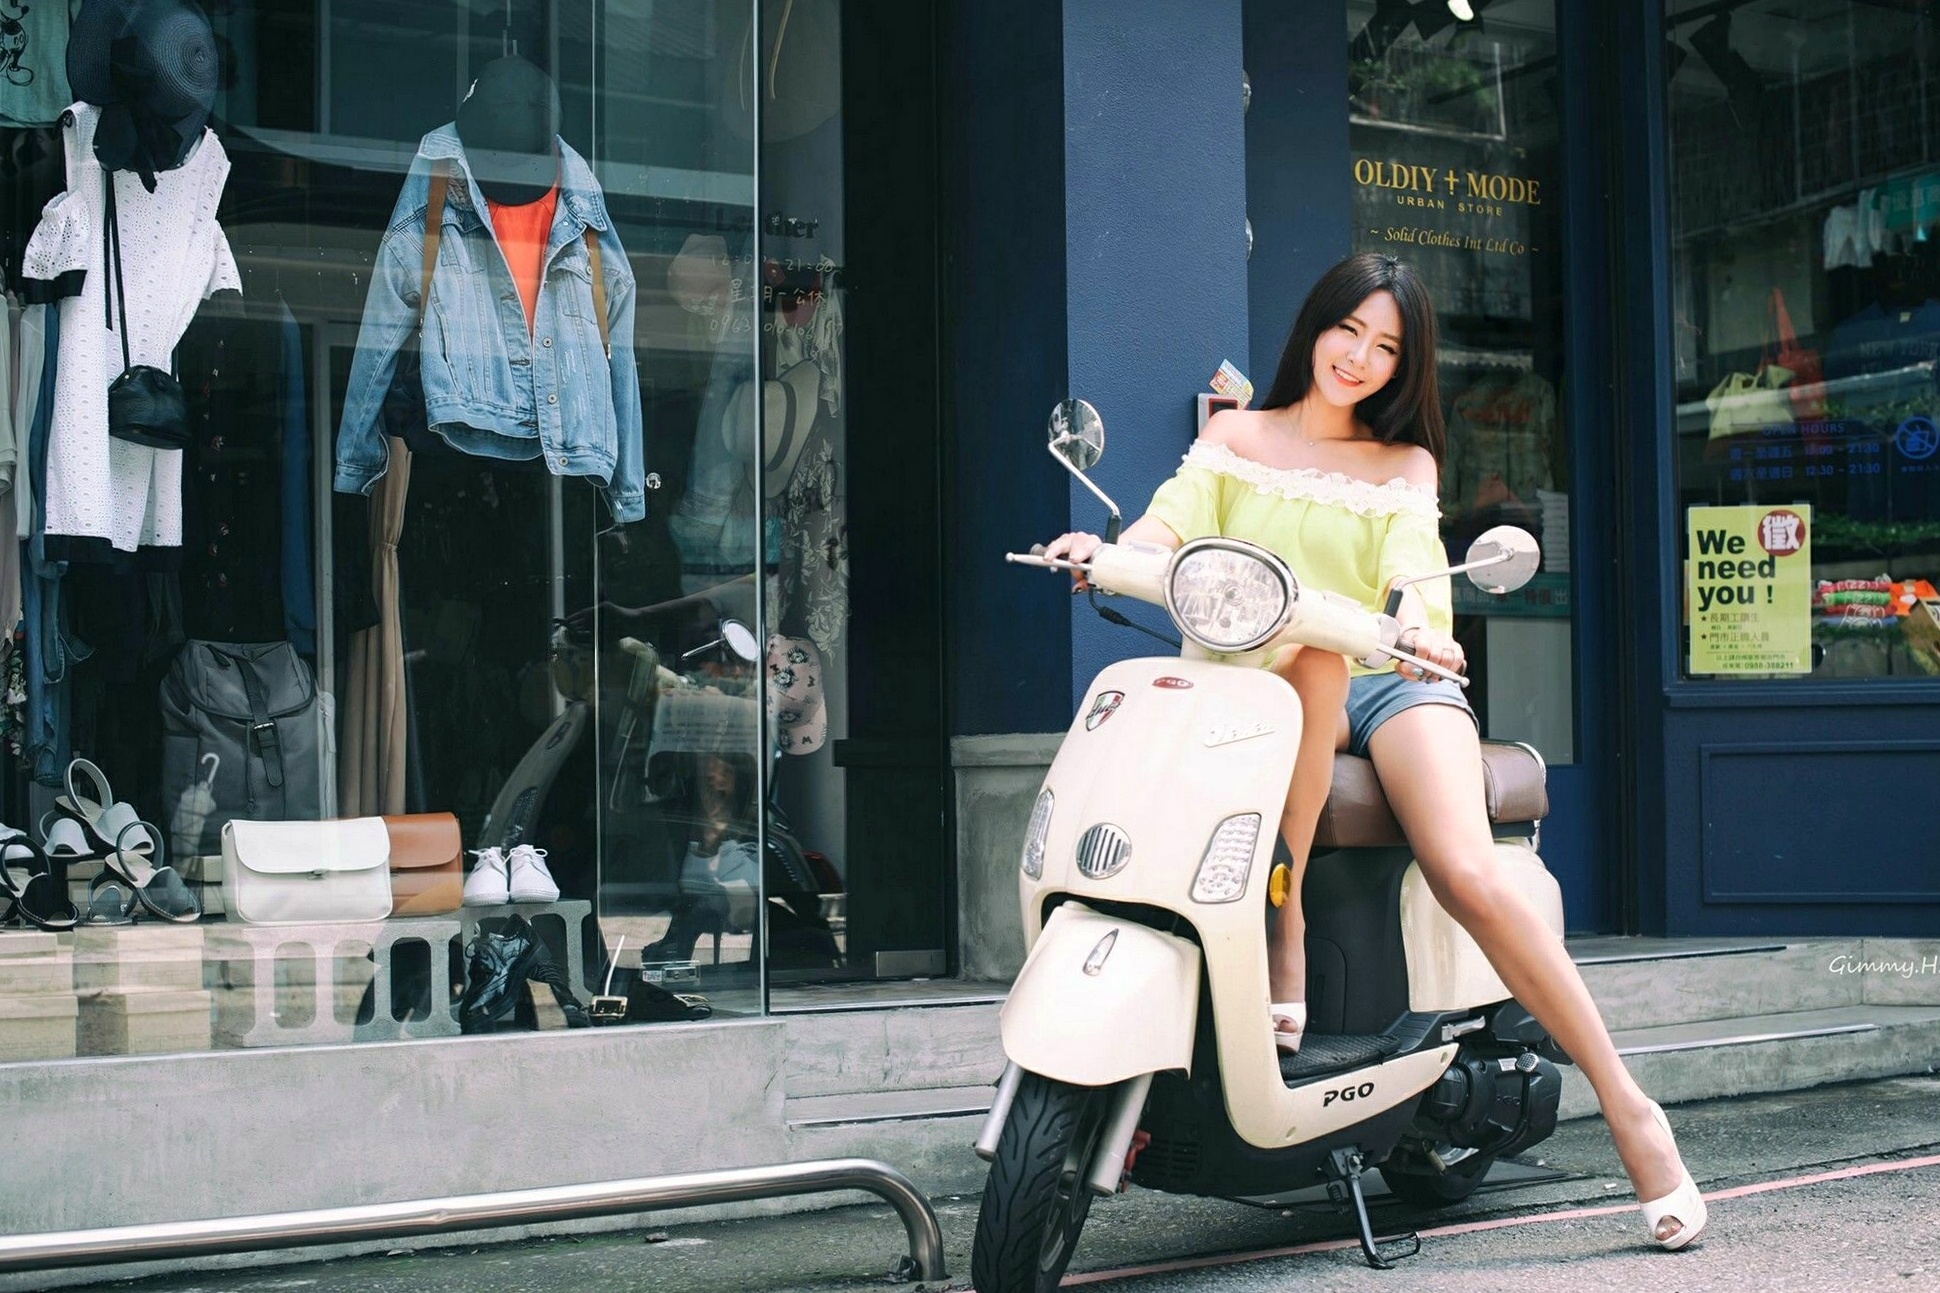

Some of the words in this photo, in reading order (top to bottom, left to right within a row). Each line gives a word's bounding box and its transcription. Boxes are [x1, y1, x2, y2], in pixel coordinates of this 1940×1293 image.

[1354, 158, 1437, 192] OLDIY
[1466, 172, 1541, 205] MODE
[1396, 194, 1445, 210] URBAN
[1458, 202, 1503, 217] STORE
[716, 206, 820, 238] Lether
[1384, 226, 1415, 243] Solid
[1418, 229, 1461, 248] Clothes
[1464, 235, 1482, 250] Int
[1486, 238, 1507, 253] Ltd
[1509, 240, 1526, 256] Co
[711, 253, 767, 266] 12:0
[1762, 424, 1797, 435] OPEN
[1801, 423, 1845, 434] HOURS
[1696, 529, 1746, 555] We
[1698, 553, 1776, 580] need
[1697, 585, 1755, 612] you
[1322, 1081, 1375, 1108] PGO
